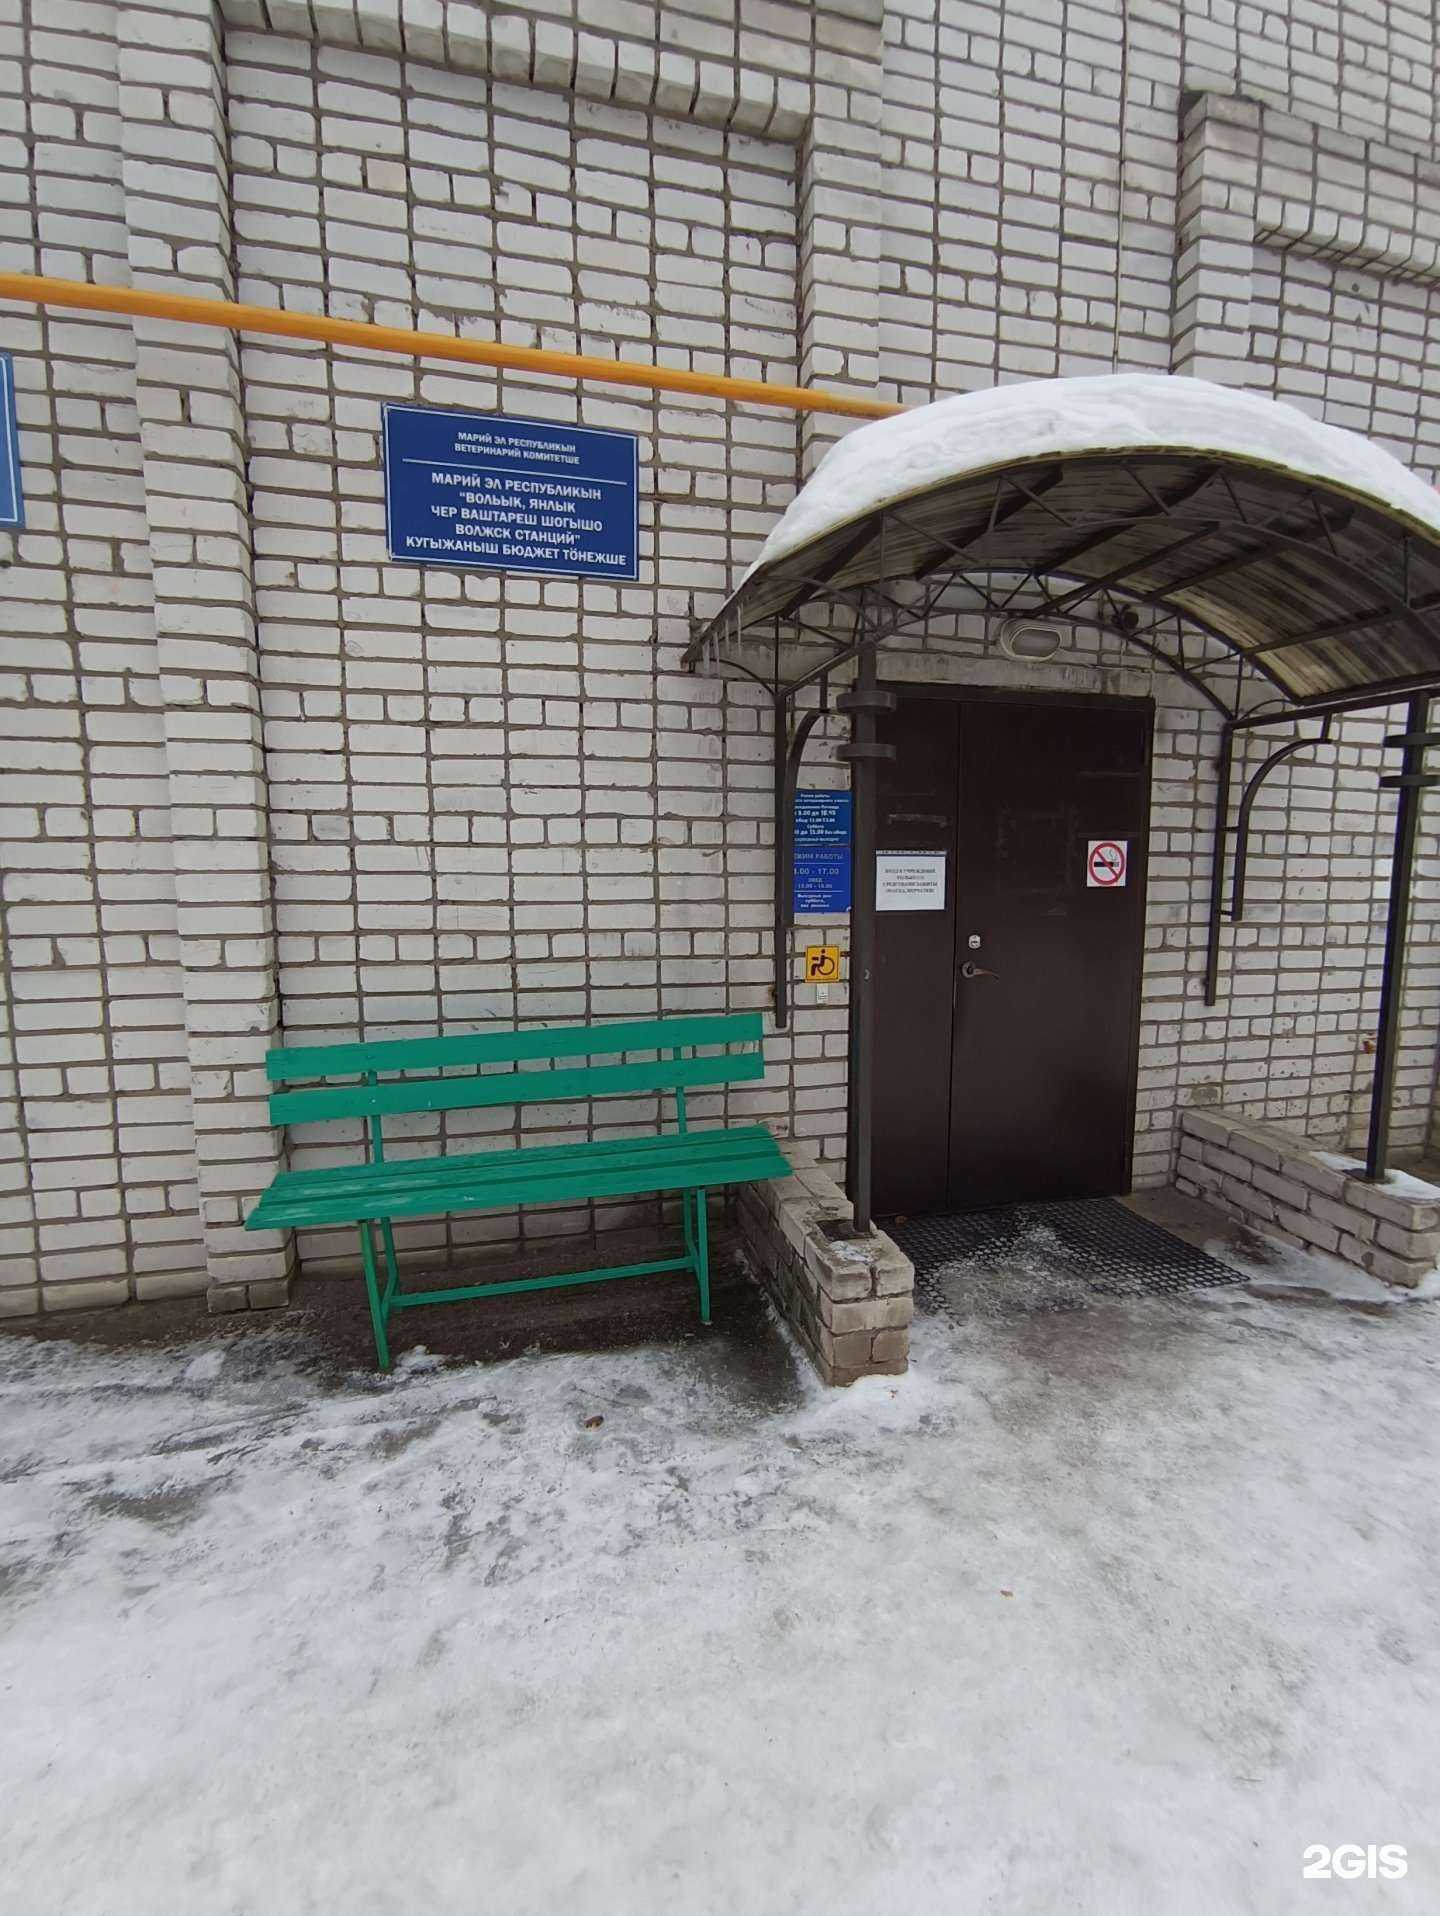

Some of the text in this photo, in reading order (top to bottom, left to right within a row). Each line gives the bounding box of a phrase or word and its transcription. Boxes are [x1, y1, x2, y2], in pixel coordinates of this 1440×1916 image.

[458, 432, 576, 453] МАРИЙ ЭЛ РЕСПУБЛИКЫН
[454, 443, 580, 465] ВЕТЕРИНАРИЙ КОМИТЕТШЕ
[432, 472, 601, 500] МАРИЙ ЭЛ РЕСПУБЛИКЫН
[529, 499, 576, 513] ЯНЛЫК
[431, 506, 603, 532] ЧЕР ВАШТАРЕШ ШОГЫШО
[456, 523, 511, 539] ВОЛЖСК
[406, 536, 627, 566] КУГЫЖАНЫШ БЮДЖЕТ ТӦНЕЖШЕ
